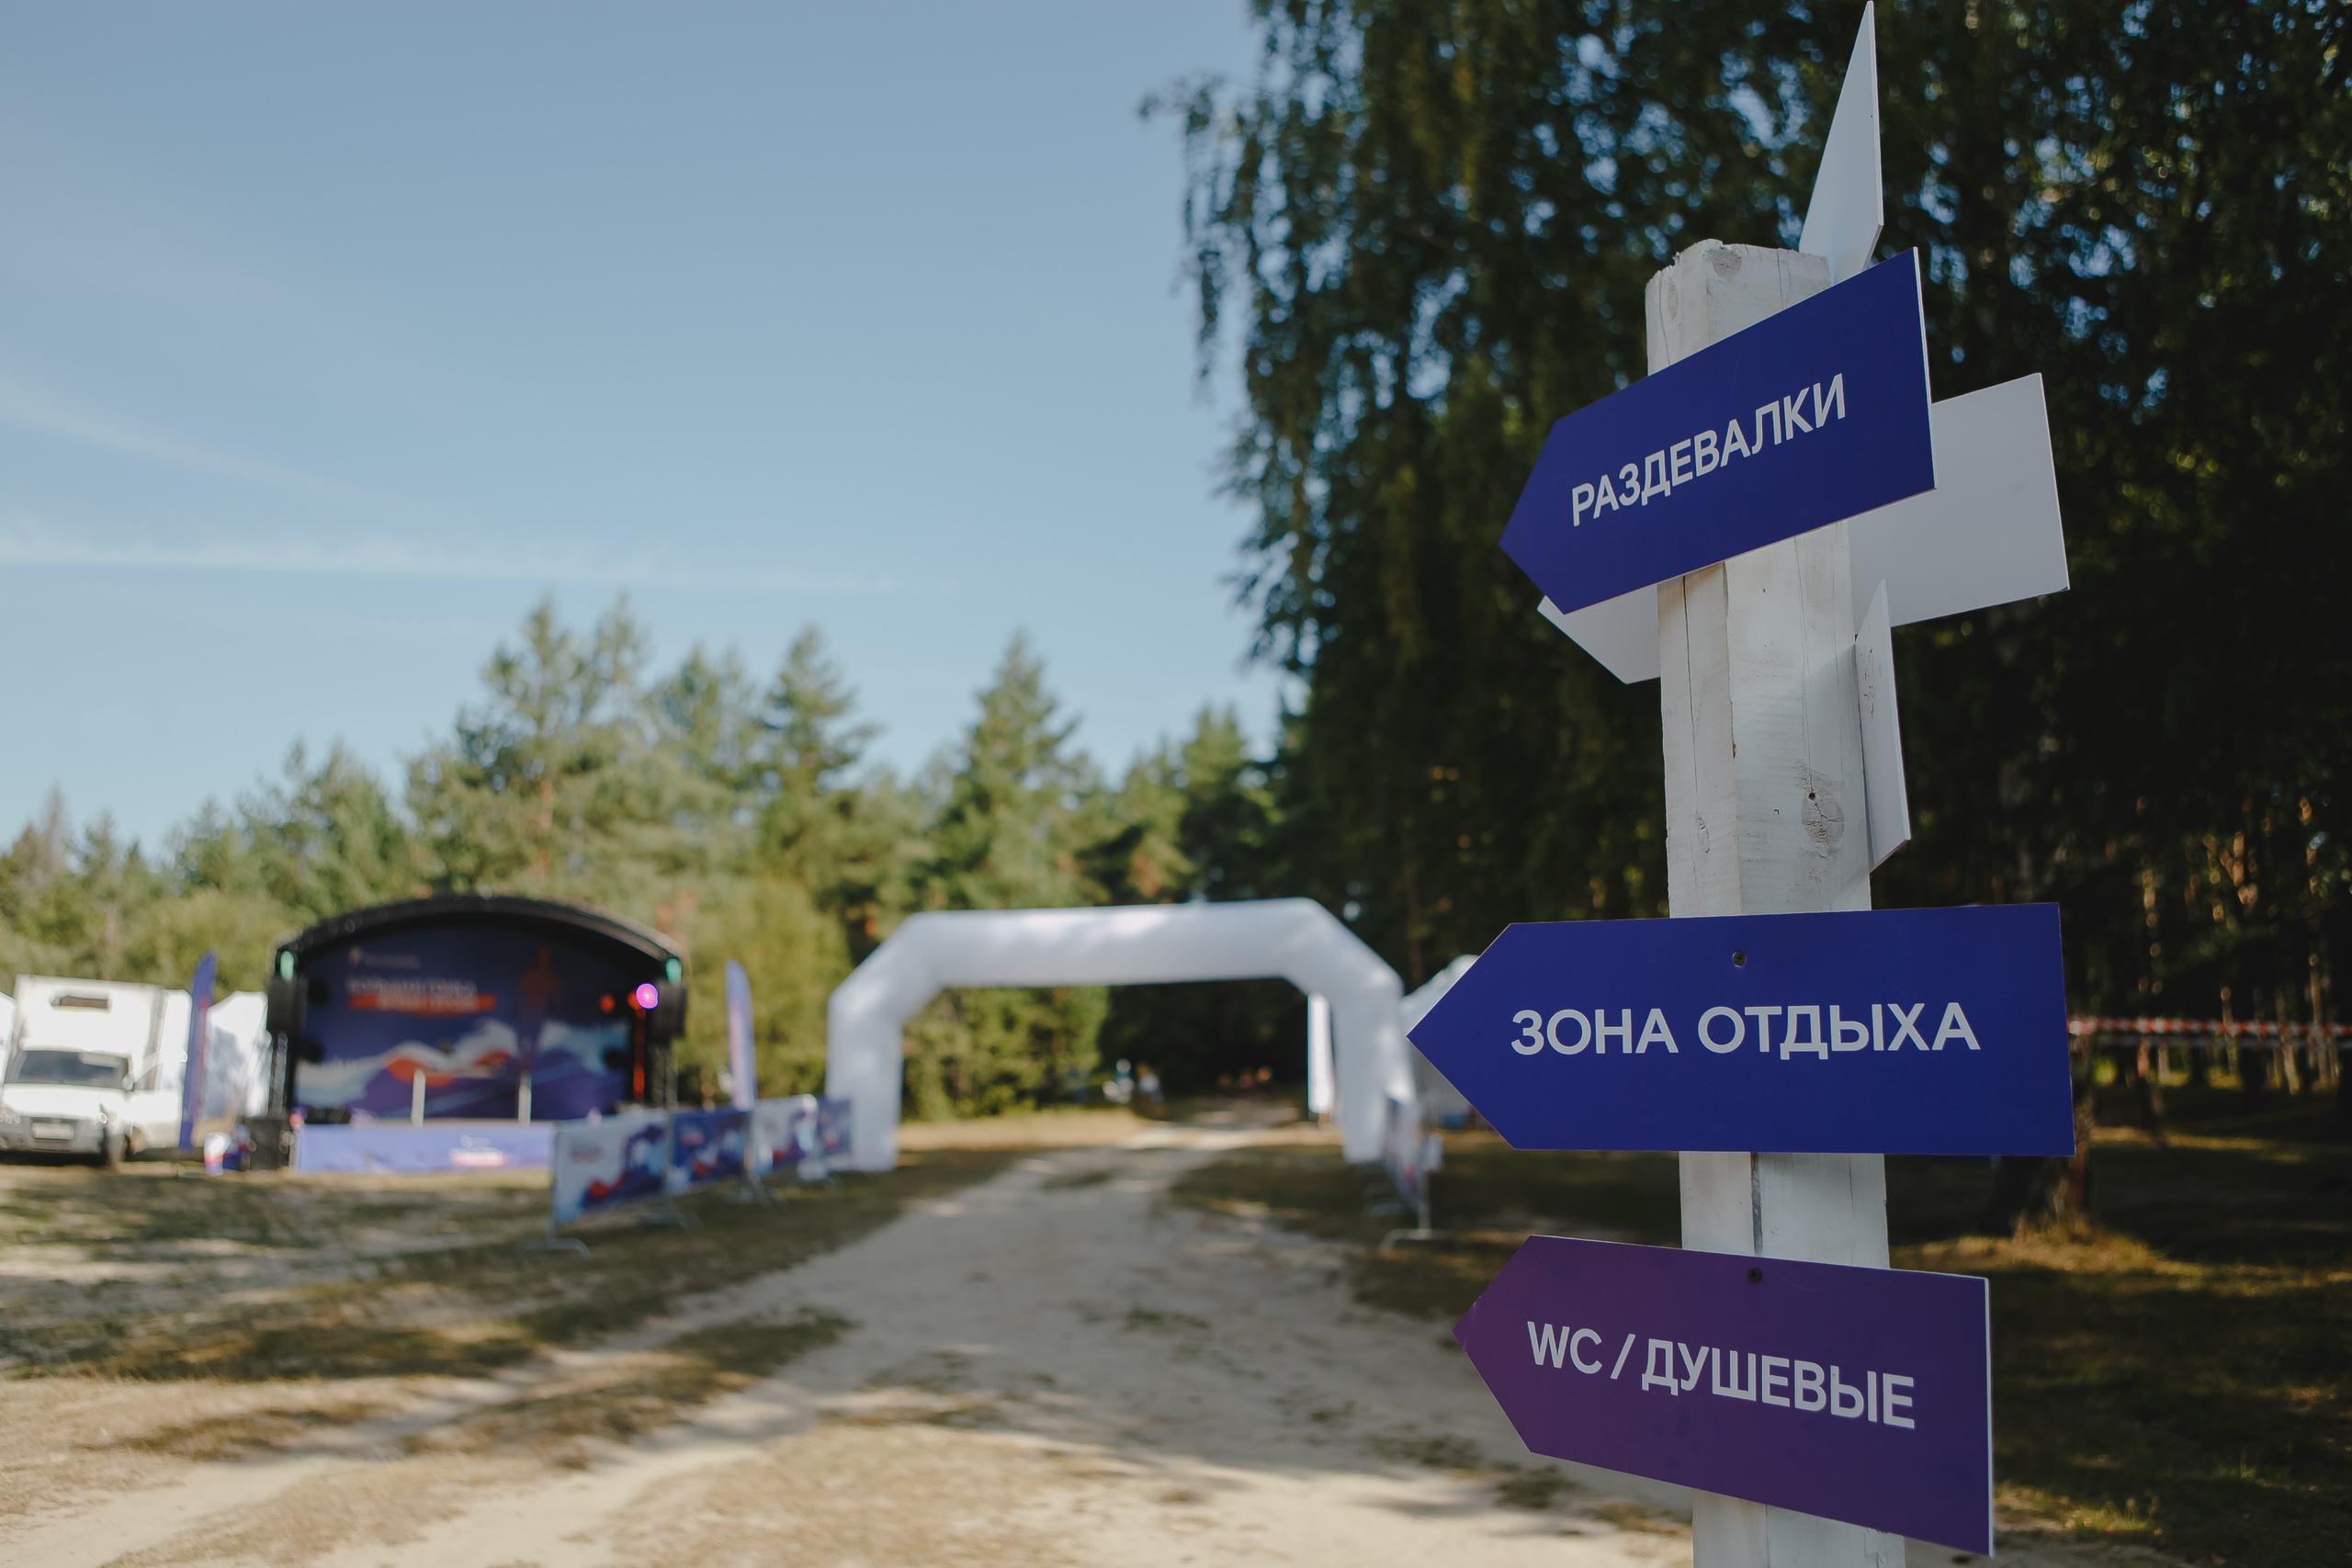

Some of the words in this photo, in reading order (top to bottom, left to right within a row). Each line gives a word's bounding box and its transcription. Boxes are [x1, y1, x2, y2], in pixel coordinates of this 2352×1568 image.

[1571, 372, 1847, 528] РАЗДЕВАЛКИ
[1510, 1008, 1680, 1056] ЗОНА
[1697, 1002, 1982, 1061] ОТДЫХА
